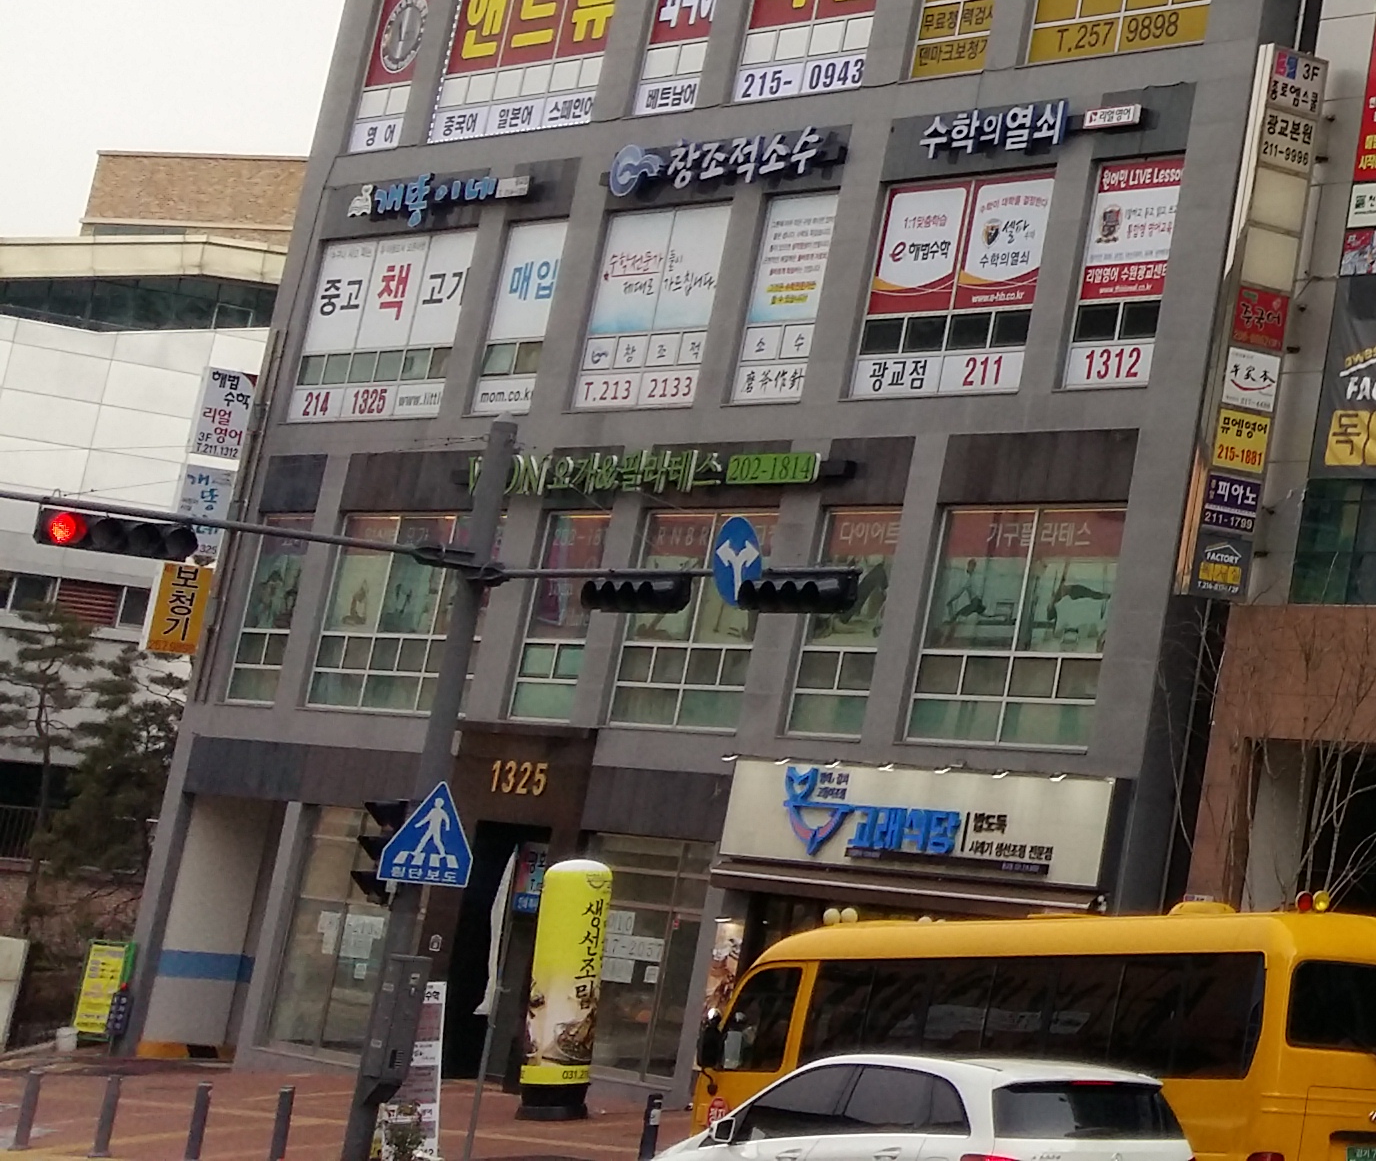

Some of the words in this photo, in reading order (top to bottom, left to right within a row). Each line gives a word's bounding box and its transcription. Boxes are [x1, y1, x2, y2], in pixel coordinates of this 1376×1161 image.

[1126, 12, 1179, 43] 9898
[1303, 63, 1320, 82] 3F
[646, 83, 697, 110] 베트남어
[1269, 80, 1319, 113] 종로엠스쿨
[443, 112, 479, 137] 중국어
[498, 105, 534, 130] 일본어
[919, 99, 1066, 159] 수학의열쇠
[1266, 114, 1313, 146] 광교본원
[667, 126, 821, 190] 창조적소수
[1262, 141, 1309, 166] 211-9996
[1129, 170, 1152, 186] LIVE
[1153, 168, 1184, 184] Lesso
[908, 240, 952, 262] 해법수학
[980, 250, 1030, 268] 수학의열쇠
[320, 278, 363, 317] 중고
[377, 263, 412, 321] 책
[508, 258, 558, 301] 매입
[1241, 303, 1282, 330] 중국어
[212, 370, 240, 391] 해법
[869, 359, 929, 393] 광교점
[962, 355, 1004, 387] 211
[1085, 347, 1142, 381] 1312
[223, 391, 251, 410] 수학
[648, 376, 693, 400] 2133
[302, 390, 330, 417] 214
[351, 388, 388, 415] 1325
[203, 407, 232, 426] 리얼
[1220, 417, 1267, 438] 뮤엠영어
[213, 426, 243, 446] 영어
[1217, 444, 1263, 467] 215-1881
[730, 456, 812, 481] 202-1814
[1217, 480, 1257, 506] 피아노
[840, 520, 900, 545] 다이어트
[1204, 511, 1253, 530] 211-1799
[986, 522, 1092, 549] 기구필라테스
[1206, 551, 1239, 564] FACTORY
[162, 566, 199, 641] 보청기
[490, 759, 549, 796] 1325
[391, 866, 457, 884] 횡단보도
[575, 898, 605, 1011] 생선조림
